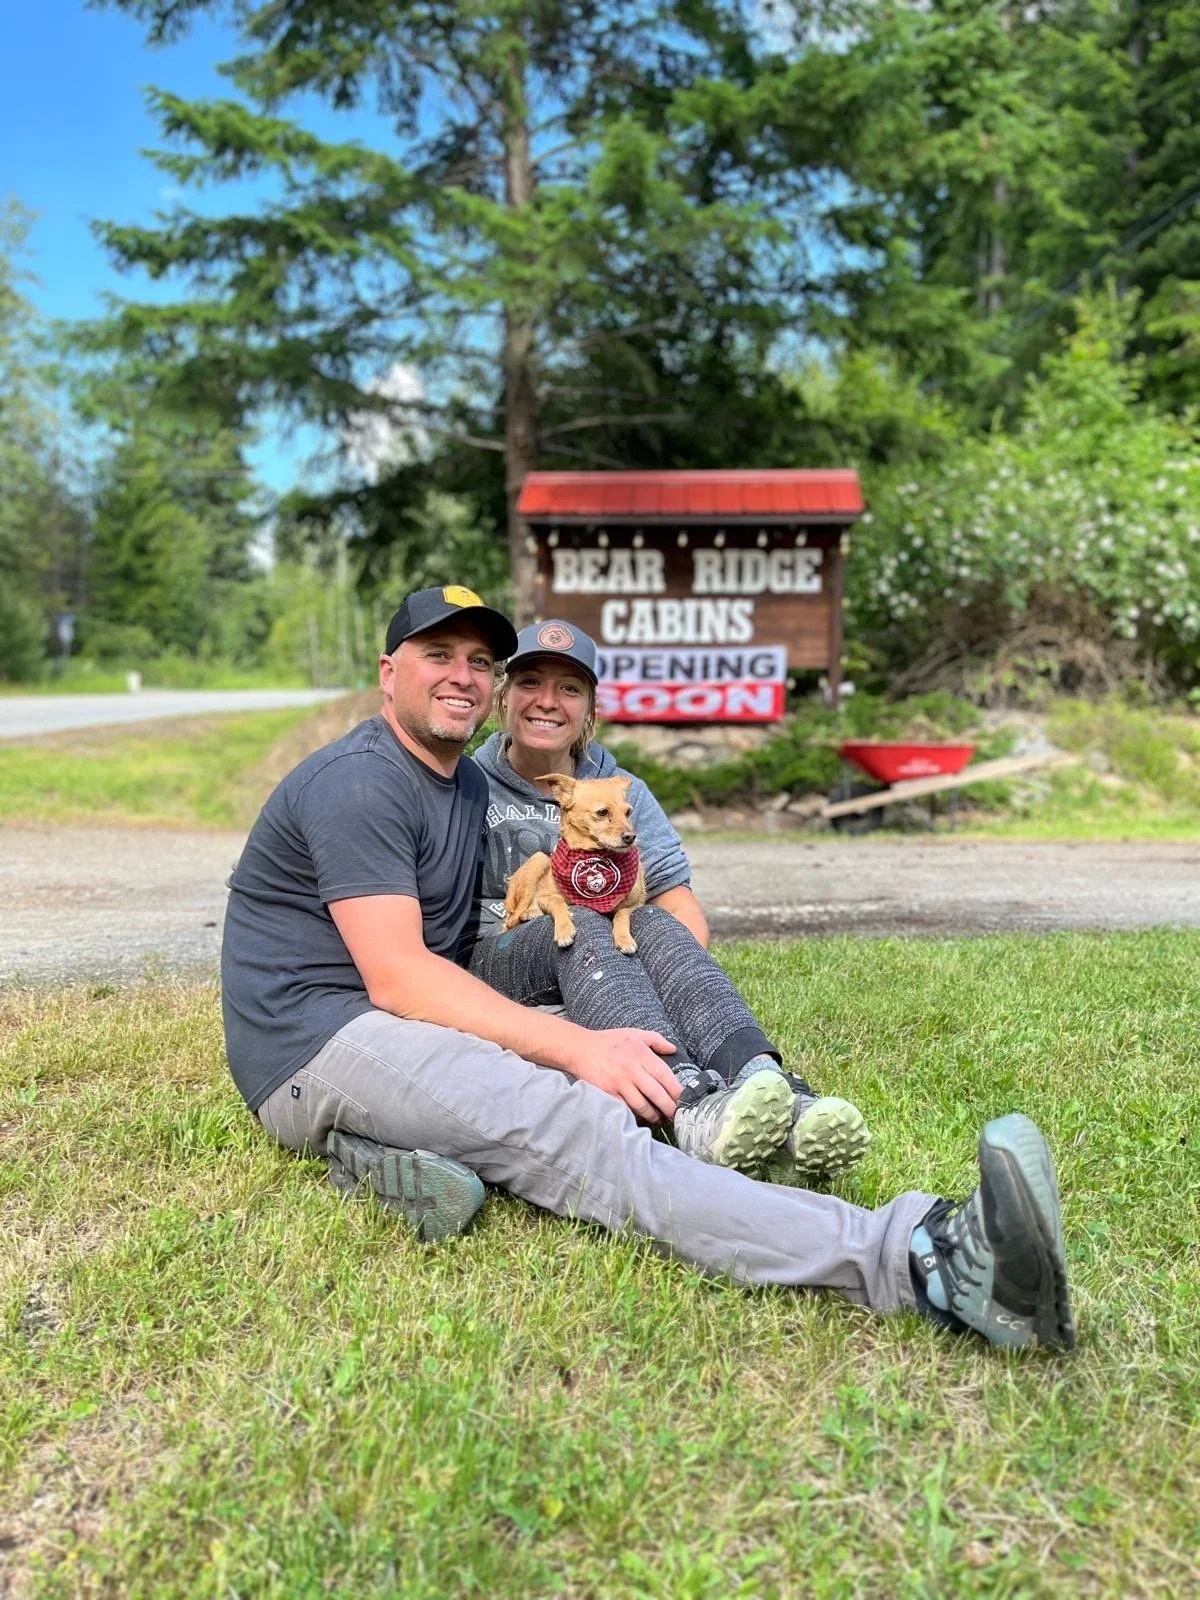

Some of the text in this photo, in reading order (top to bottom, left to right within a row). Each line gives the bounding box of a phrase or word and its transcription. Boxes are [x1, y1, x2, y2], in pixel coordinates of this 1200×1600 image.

[552, 549, 823, 593] BEAR RIDGE
[601, 599, 754, 643] CABINS
[483, 803, 561, 833] HALL
